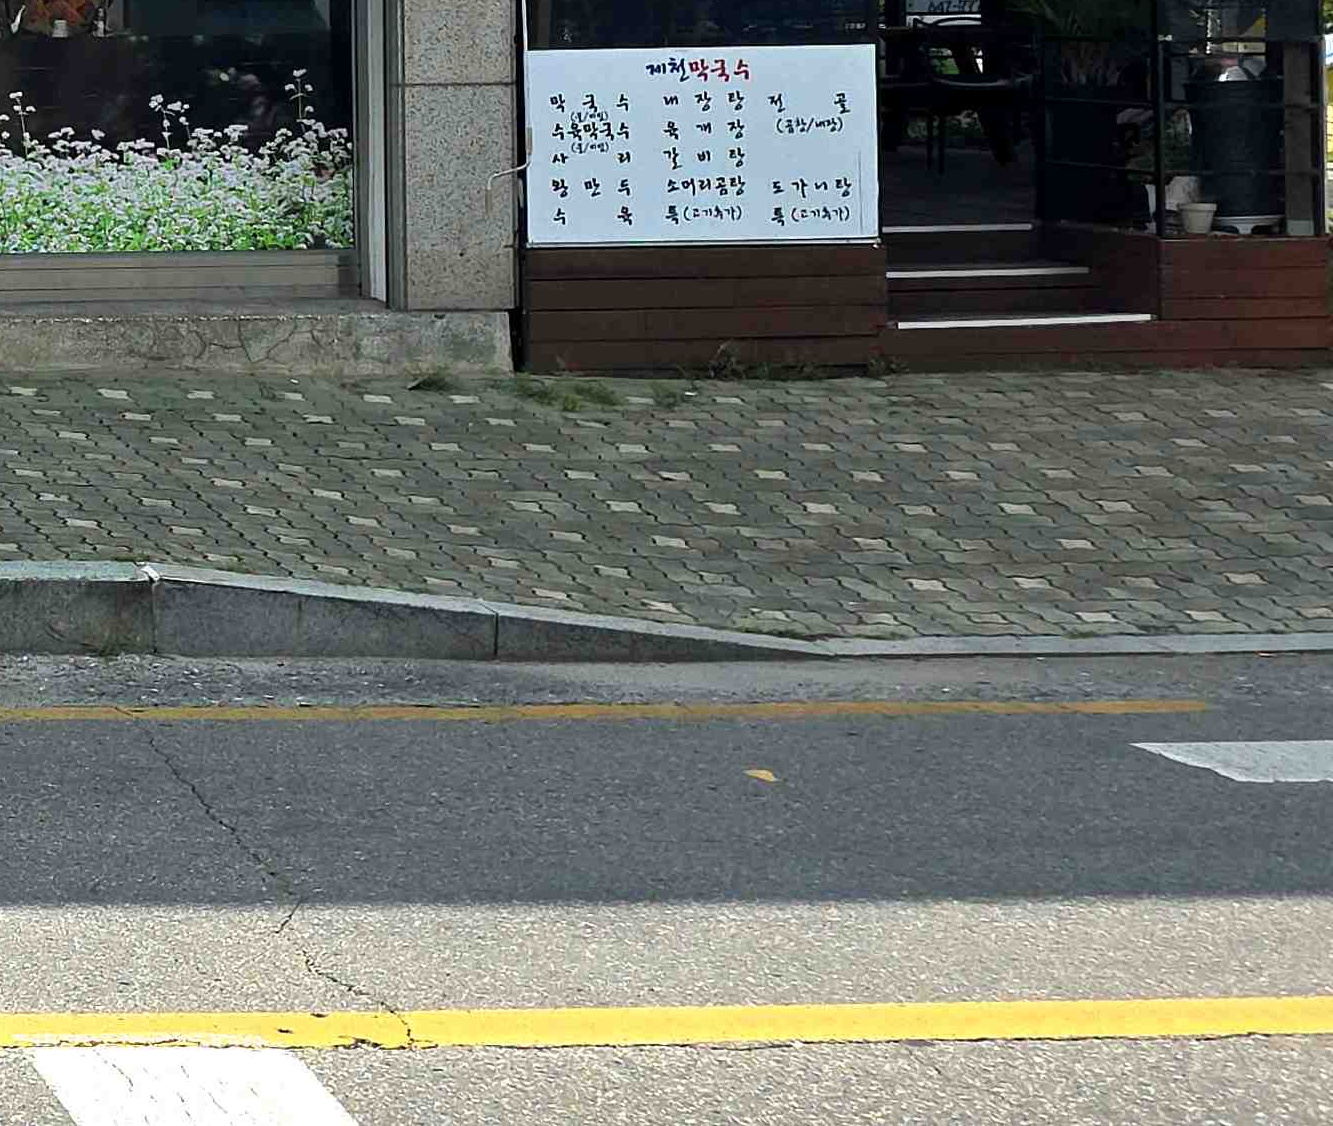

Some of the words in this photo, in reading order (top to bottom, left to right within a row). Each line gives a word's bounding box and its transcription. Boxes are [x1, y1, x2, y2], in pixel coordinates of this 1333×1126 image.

[646, 58, 750, 82] 제천막국수
[550, 94, 629, 112] 막국수
[663, 90, 744, 111] 내장탕
[767, 92, 850, 113] 전골
[552, 123, 630, 141] 수육막국수
[663, 120, 744, 139] 육개장
[552, 152, 631, 164] 사리
[663, 147, 745, 169] 갈비탕
[552, 178, 631, 197] 왕만두
[667, 176, 745, 196] 소머리곰탕
[772, 177, 852, 198] 도가니탕
[553, 207, 632, 225] 수육
